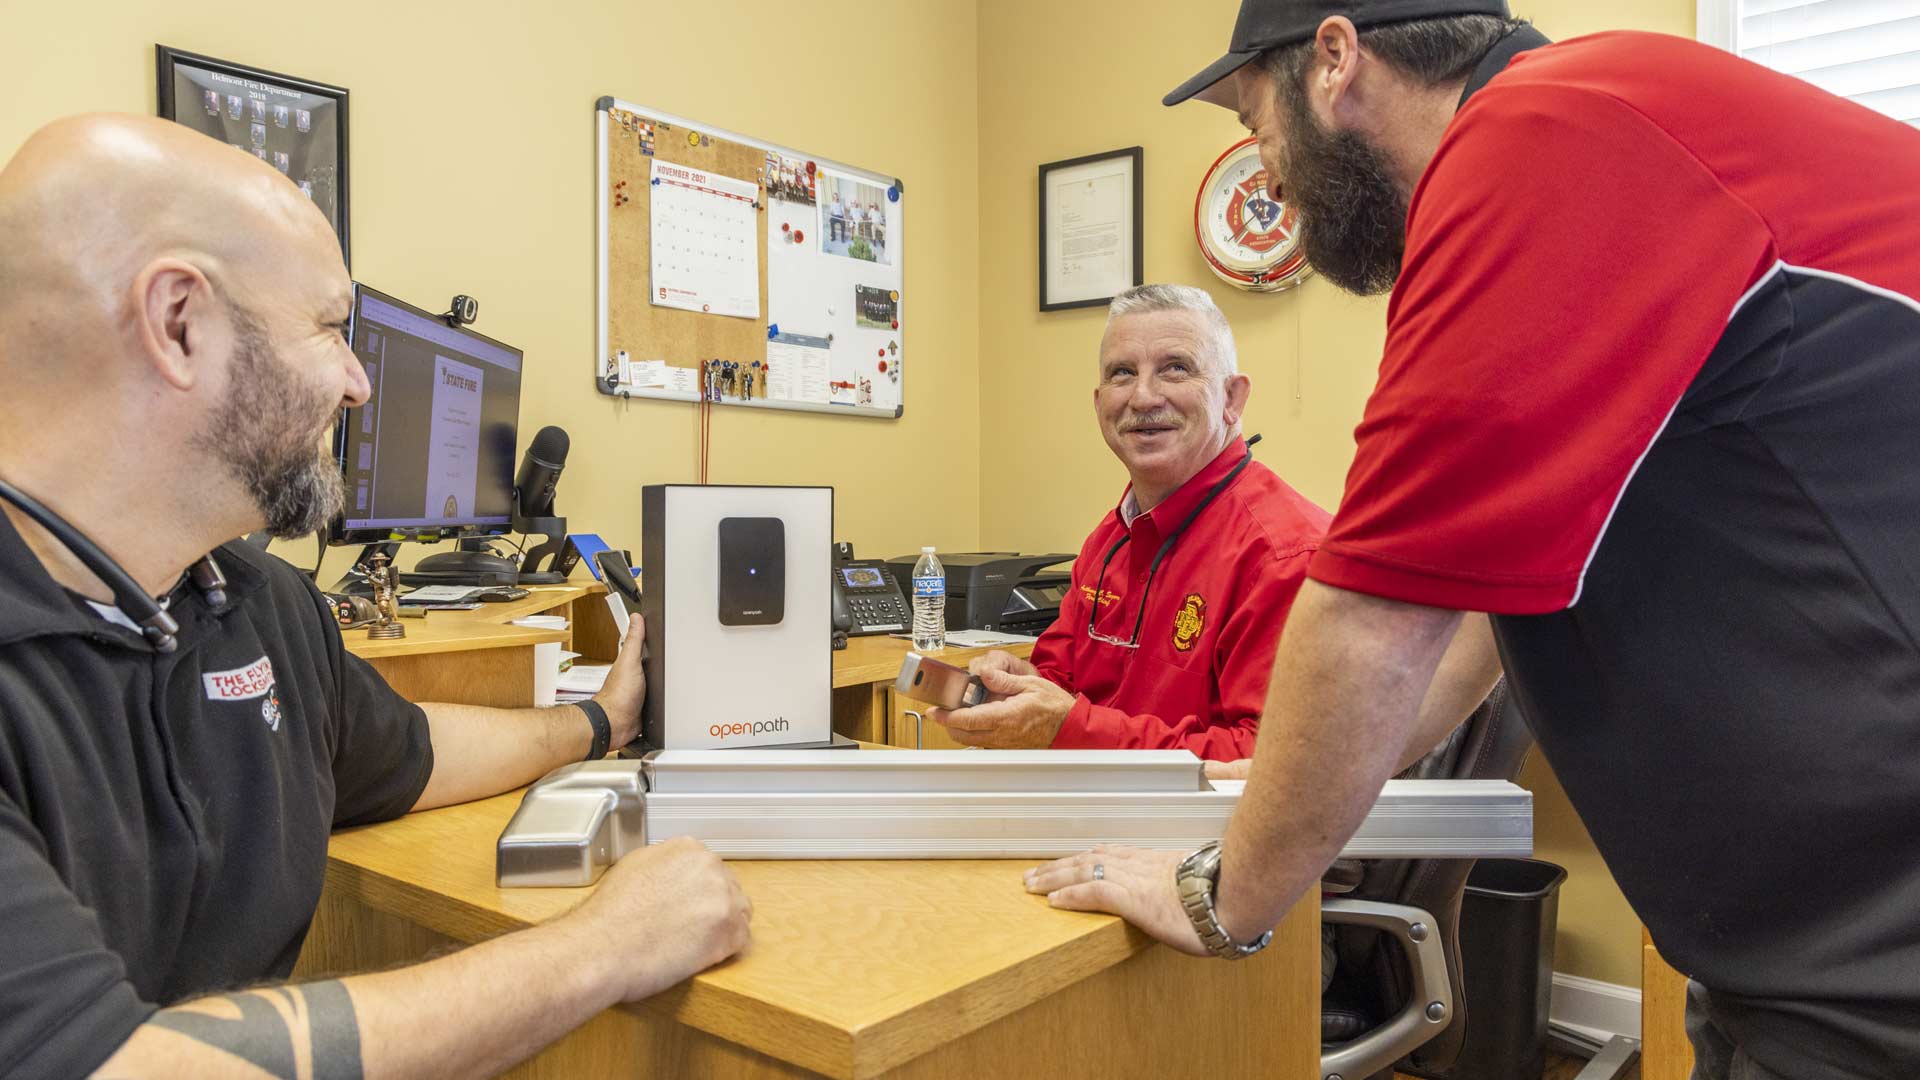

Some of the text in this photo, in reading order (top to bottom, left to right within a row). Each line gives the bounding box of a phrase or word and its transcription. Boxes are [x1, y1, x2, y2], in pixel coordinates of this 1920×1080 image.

[211, 72, 302, 99] Belmont Fire Department
[656, 165, 706, 184] NOVEMBER 2021
[446, 373, 478, 392] STATE FIRE
[211, 674, 245, 688] THE
[709, 716, 789, 739] openpath
